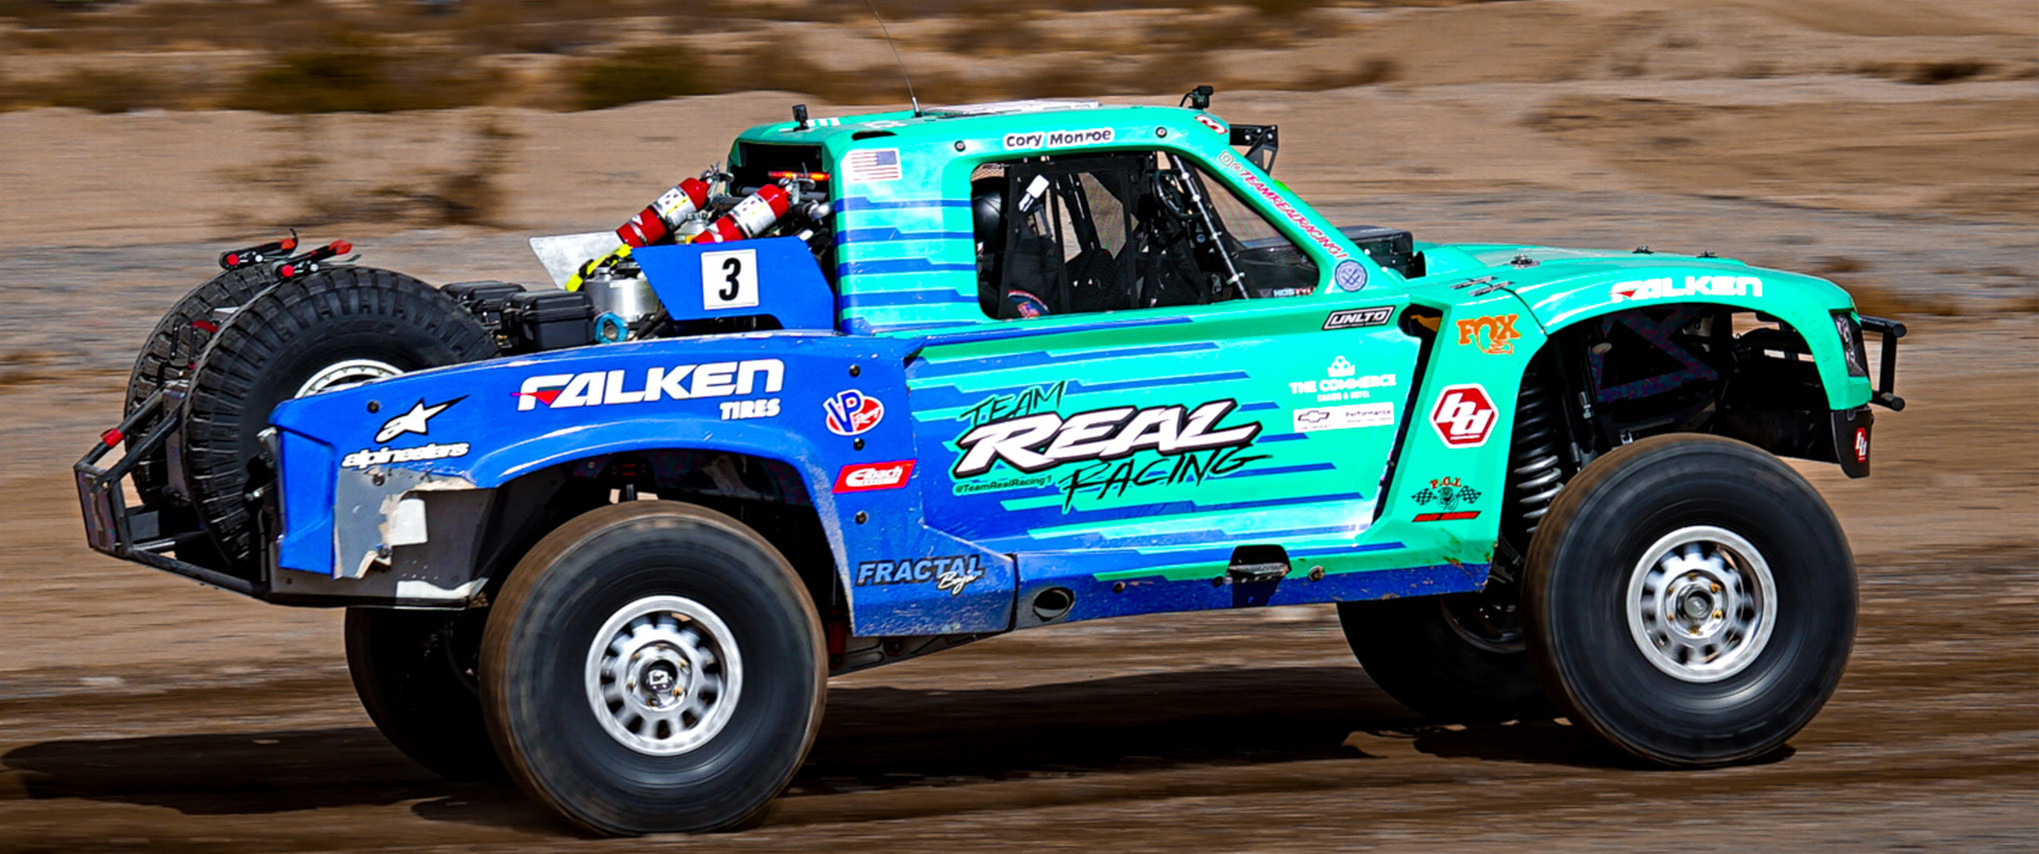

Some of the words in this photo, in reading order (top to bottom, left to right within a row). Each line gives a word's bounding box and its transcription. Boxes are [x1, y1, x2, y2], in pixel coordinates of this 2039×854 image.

[1006, 134, 1042, 147] Cory
[1050, 130, 1112, 145] Monroe
[719, 257, 741, 301] 3
[1611, 276, 1763, 303] FALKEN
[1456, 314, 1520, 355] FOX
[517, 359, 784, 411] FALKEN
[1289, 381, 1317, 394] THE
[1318, 374, 1397, 391] COMMERCE
[719, 399, 781, 420] TIRES
[824, 390, 863, 434] VP
[960, 381, 1065, 425] TEAM
[953, 398, 1262, 478] REAL
[341, 443, 469, 469] alpinestars
[955, 475, 1052, 493] @TeamRealRacing1
[1059, 446, 1273, 511] RACING
[855, 555, 984, 585] FRACTAL
